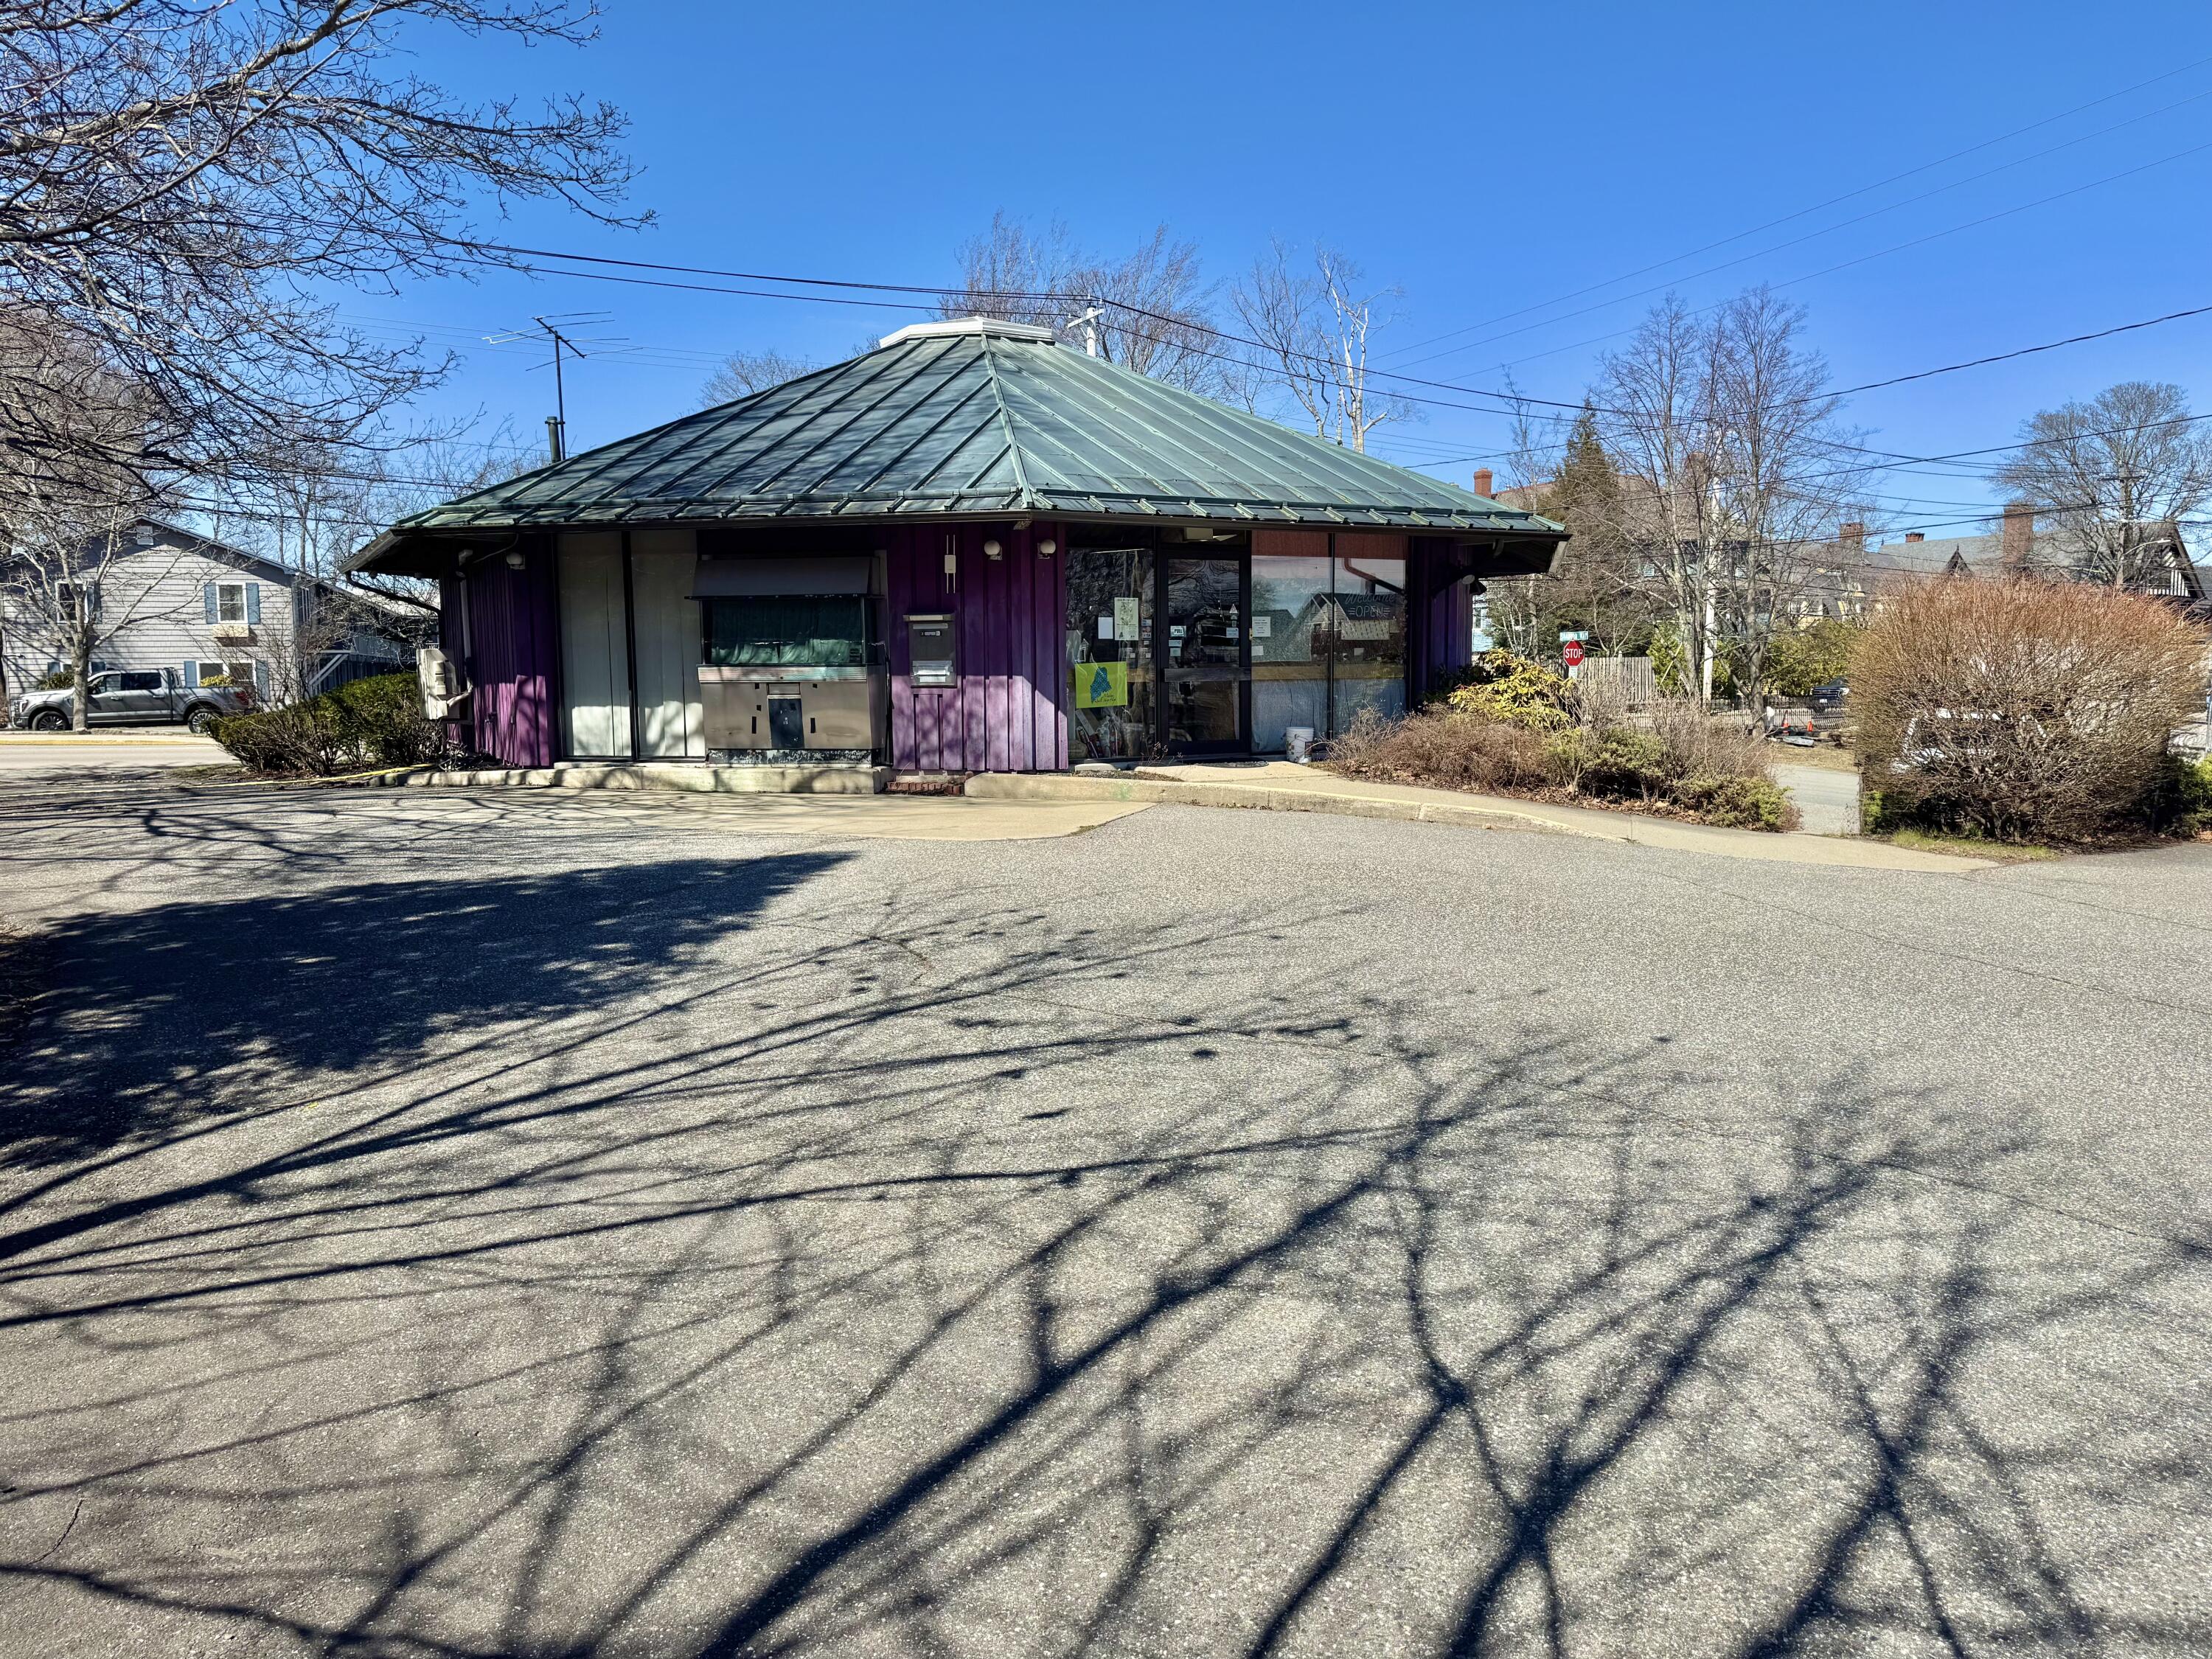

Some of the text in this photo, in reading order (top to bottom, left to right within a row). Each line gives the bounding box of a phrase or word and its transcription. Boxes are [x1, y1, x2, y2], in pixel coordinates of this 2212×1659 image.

[1345, 588, 1394, 604] Welcome
[1356, 605, 1383, 617] OPEN
[1565, 648, 1583, 658] STOP
